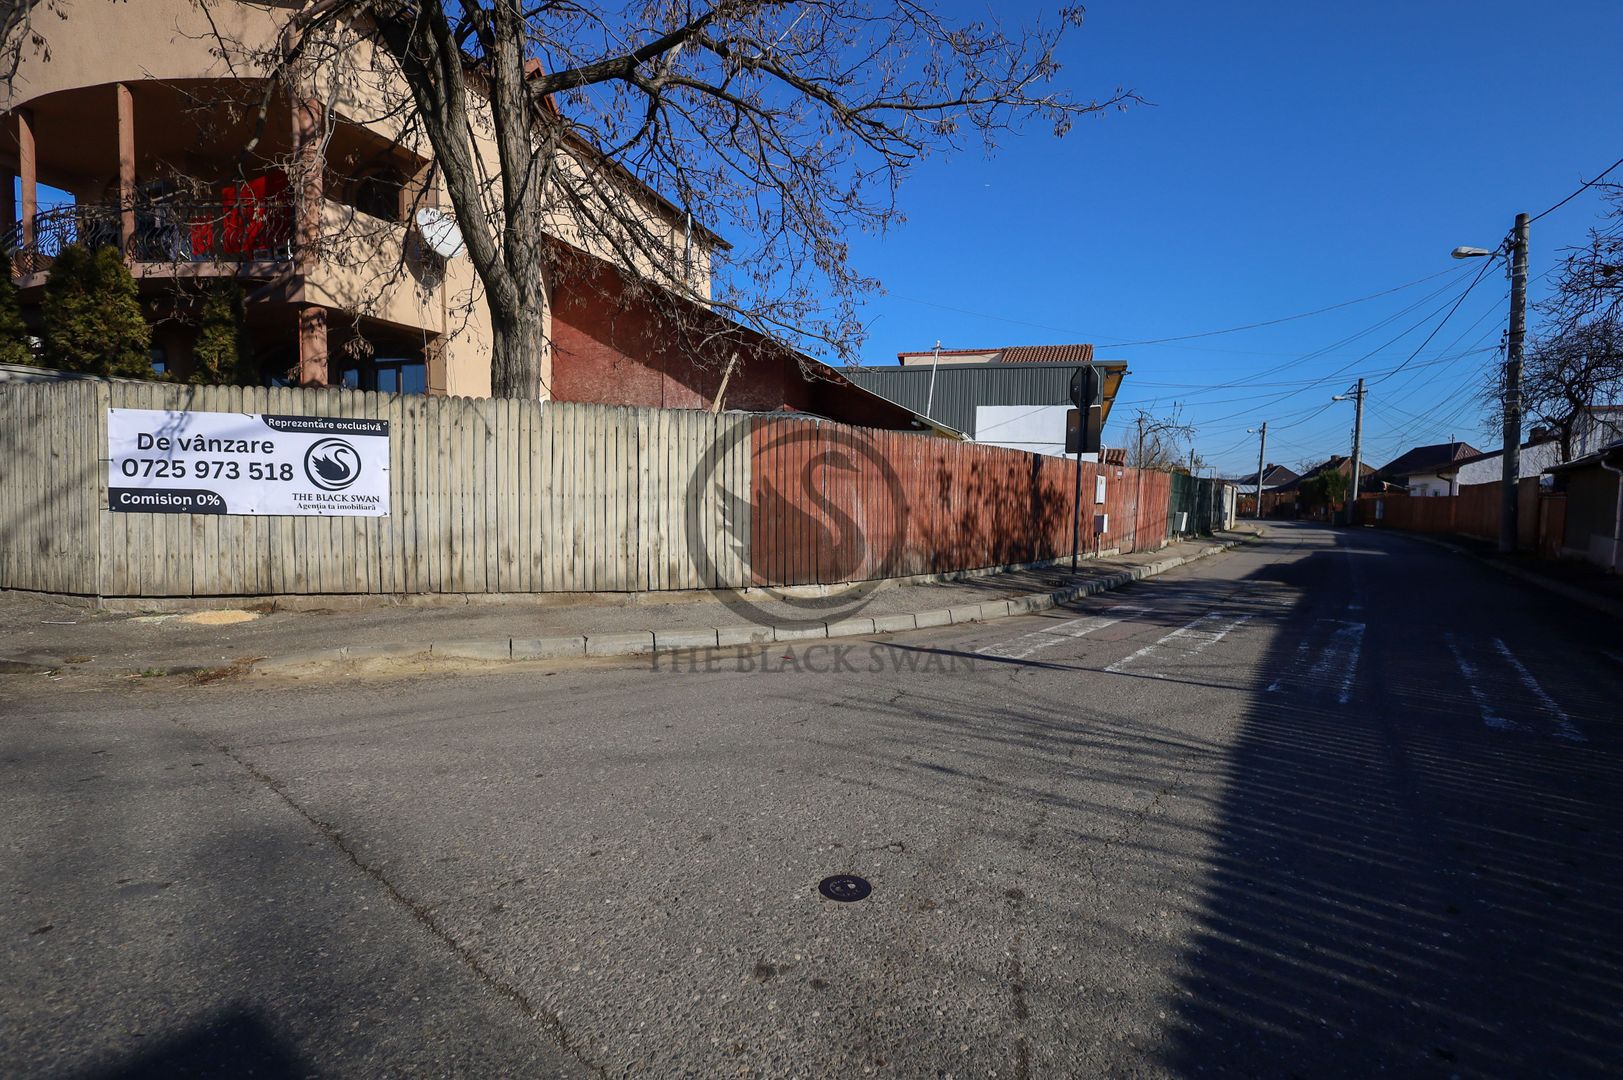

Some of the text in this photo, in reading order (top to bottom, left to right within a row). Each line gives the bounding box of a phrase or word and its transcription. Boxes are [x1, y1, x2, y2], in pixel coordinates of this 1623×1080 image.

[336, 421, 381, 431] exclusivă
[137, 433, 274, 454] De vânzare
[121, 458, 294, 481] 0725 973 518
[120, 492, 220, 506] Comision 0%
[292, 493, 380, 503] THE BLACK SWAN
